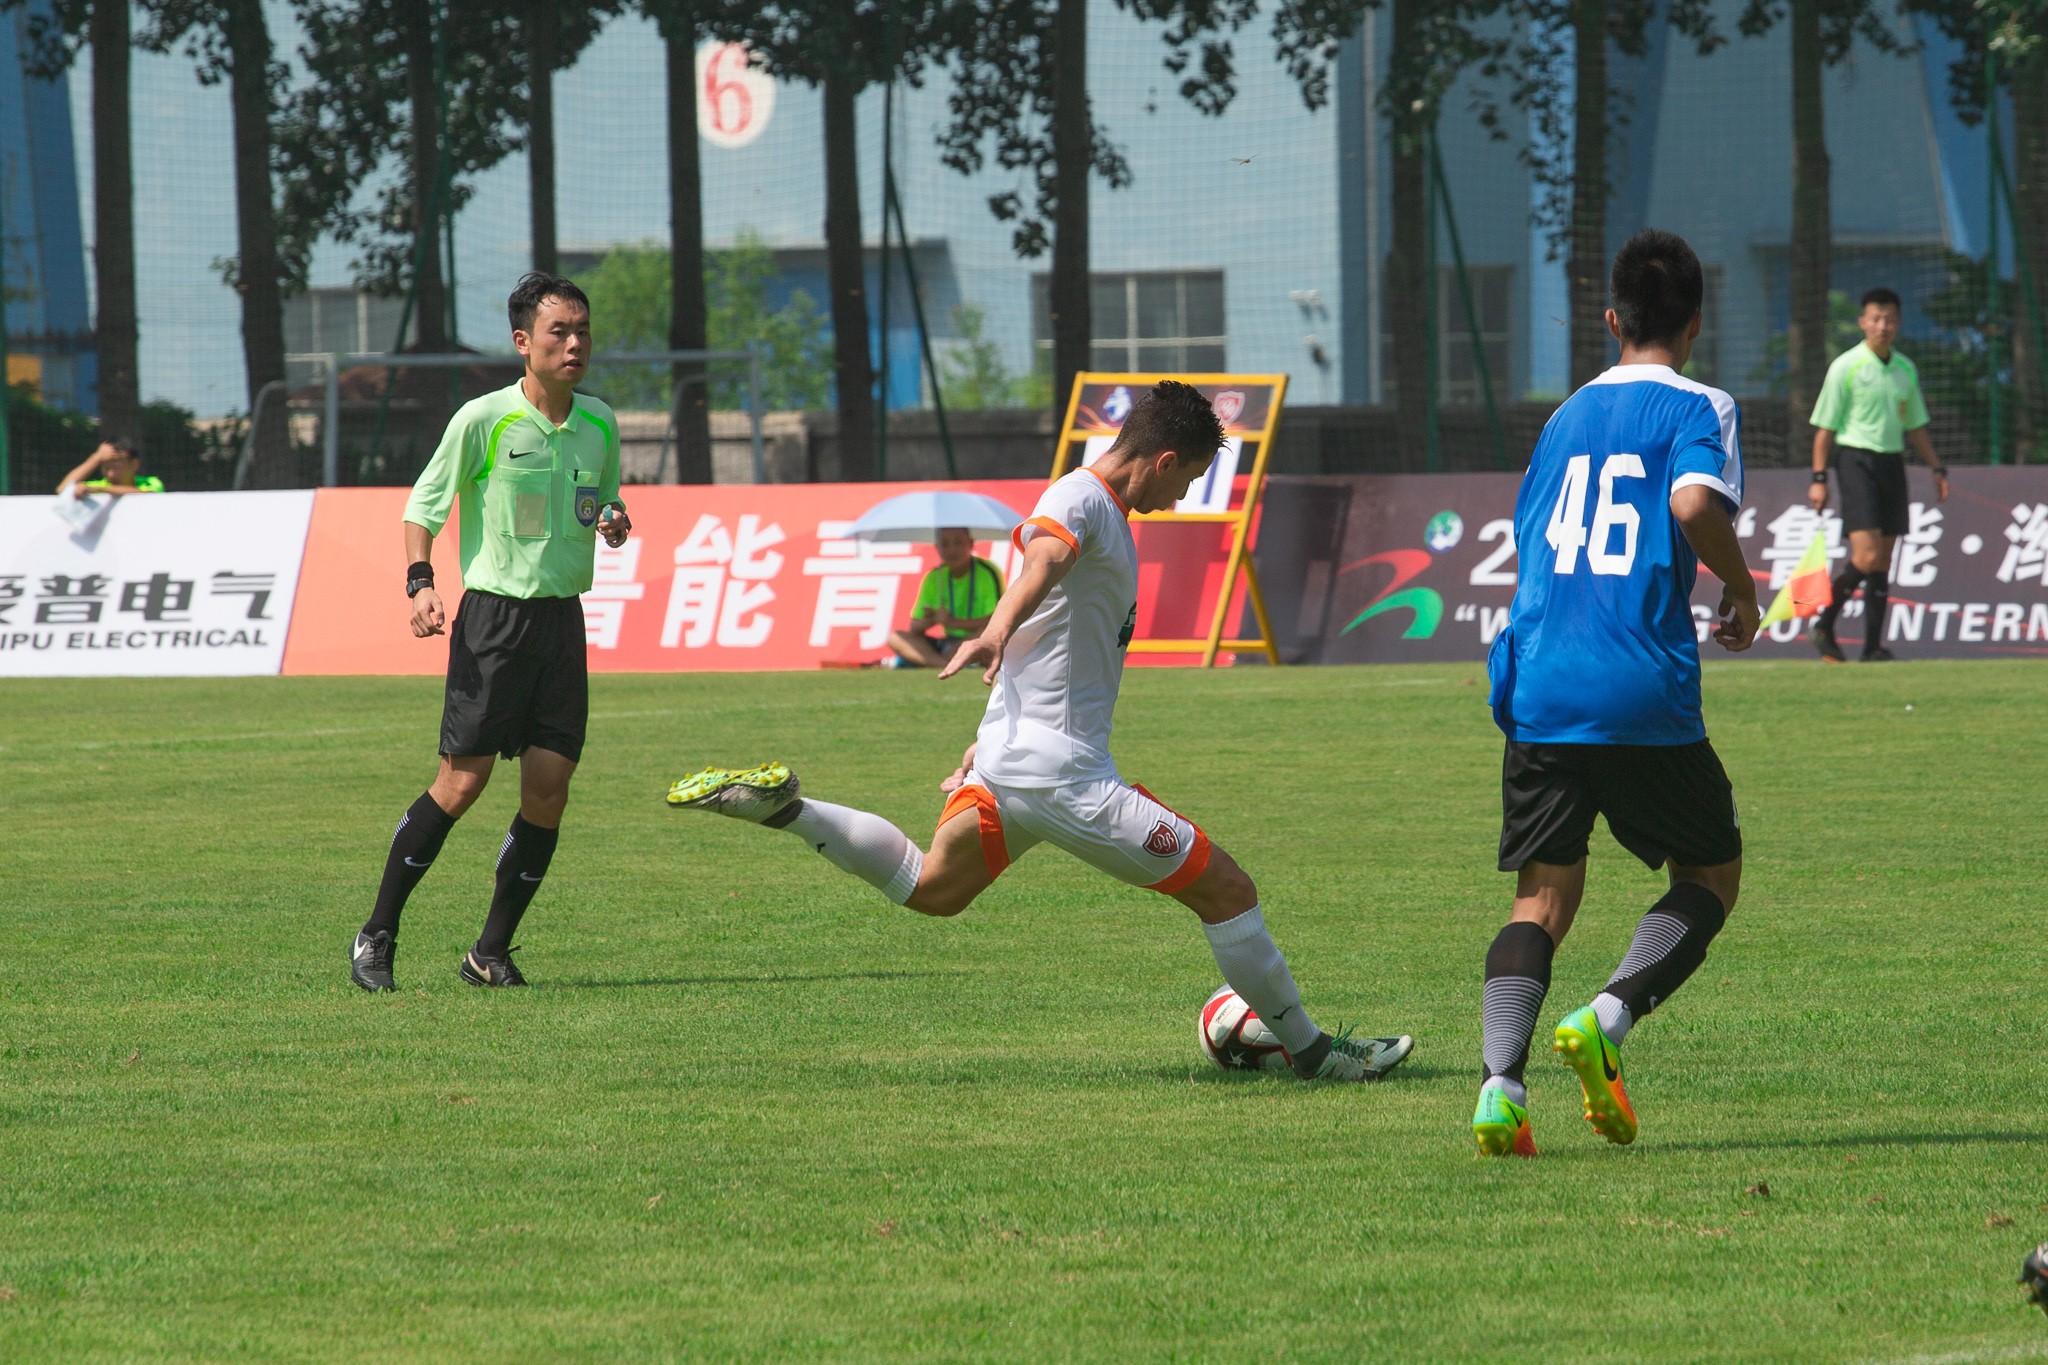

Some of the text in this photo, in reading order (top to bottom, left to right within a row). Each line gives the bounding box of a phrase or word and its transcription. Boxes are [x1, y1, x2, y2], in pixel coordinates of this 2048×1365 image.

[705, 42, 753, 135] 6
[1545, 453, 1646, 576] 46
[67, 629, 267, 650] ELECTRICAL
